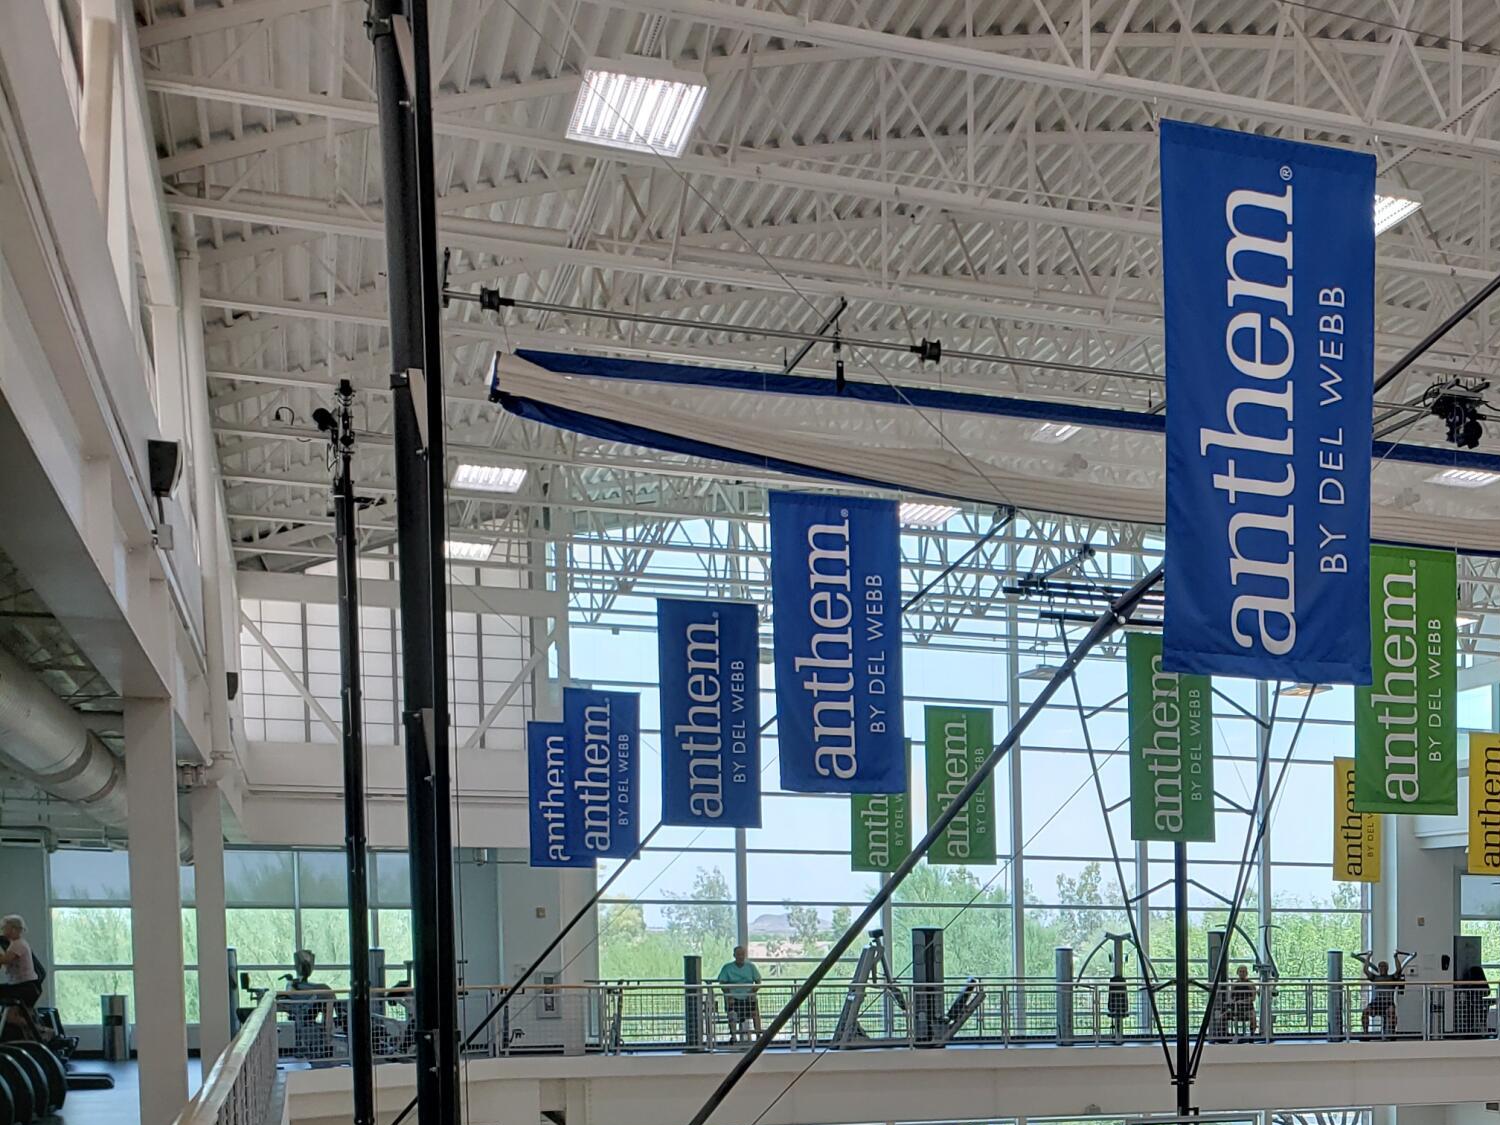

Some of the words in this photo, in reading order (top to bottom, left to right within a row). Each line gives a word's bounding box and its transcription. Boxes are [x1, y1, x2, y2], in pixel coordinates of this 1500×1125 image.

[1318, 286, 1346, 406] WEBB
[1318, 428, 1346, 506] DEL
[1319, 526, 1348, 575] BY
[866, 574, 883, 641] WEBB
[1428, 619, 1441, 679] WEBB
[731, 661, 745, 713] WEBB
[868, 651, 885, 694] DEL
[870, 706, 886, 733] BY
[1189, 689, 1200, 736] WEBB
[1428, 688, 1441, 727] DEL
[732, 720, 746, 753] DEL
[1429, 736, 1441, 761] BY
[618, 734, 629, 772] WEBB
[1191, 744, 1201, 776] DEL
[733, 762, 746, 783] BY
[618, 778, 628, 803] DEL
[976, 790, 985, 813] DEL
[1191, 782, 1201, 801] BY
[618, 810, 628, 826] BY
[895, 809, 903, 828] DEL
[976, 816, 986, 833] BY
[895, 831, 903, 846] BY
[1367, 847, 1373, 857] BY
